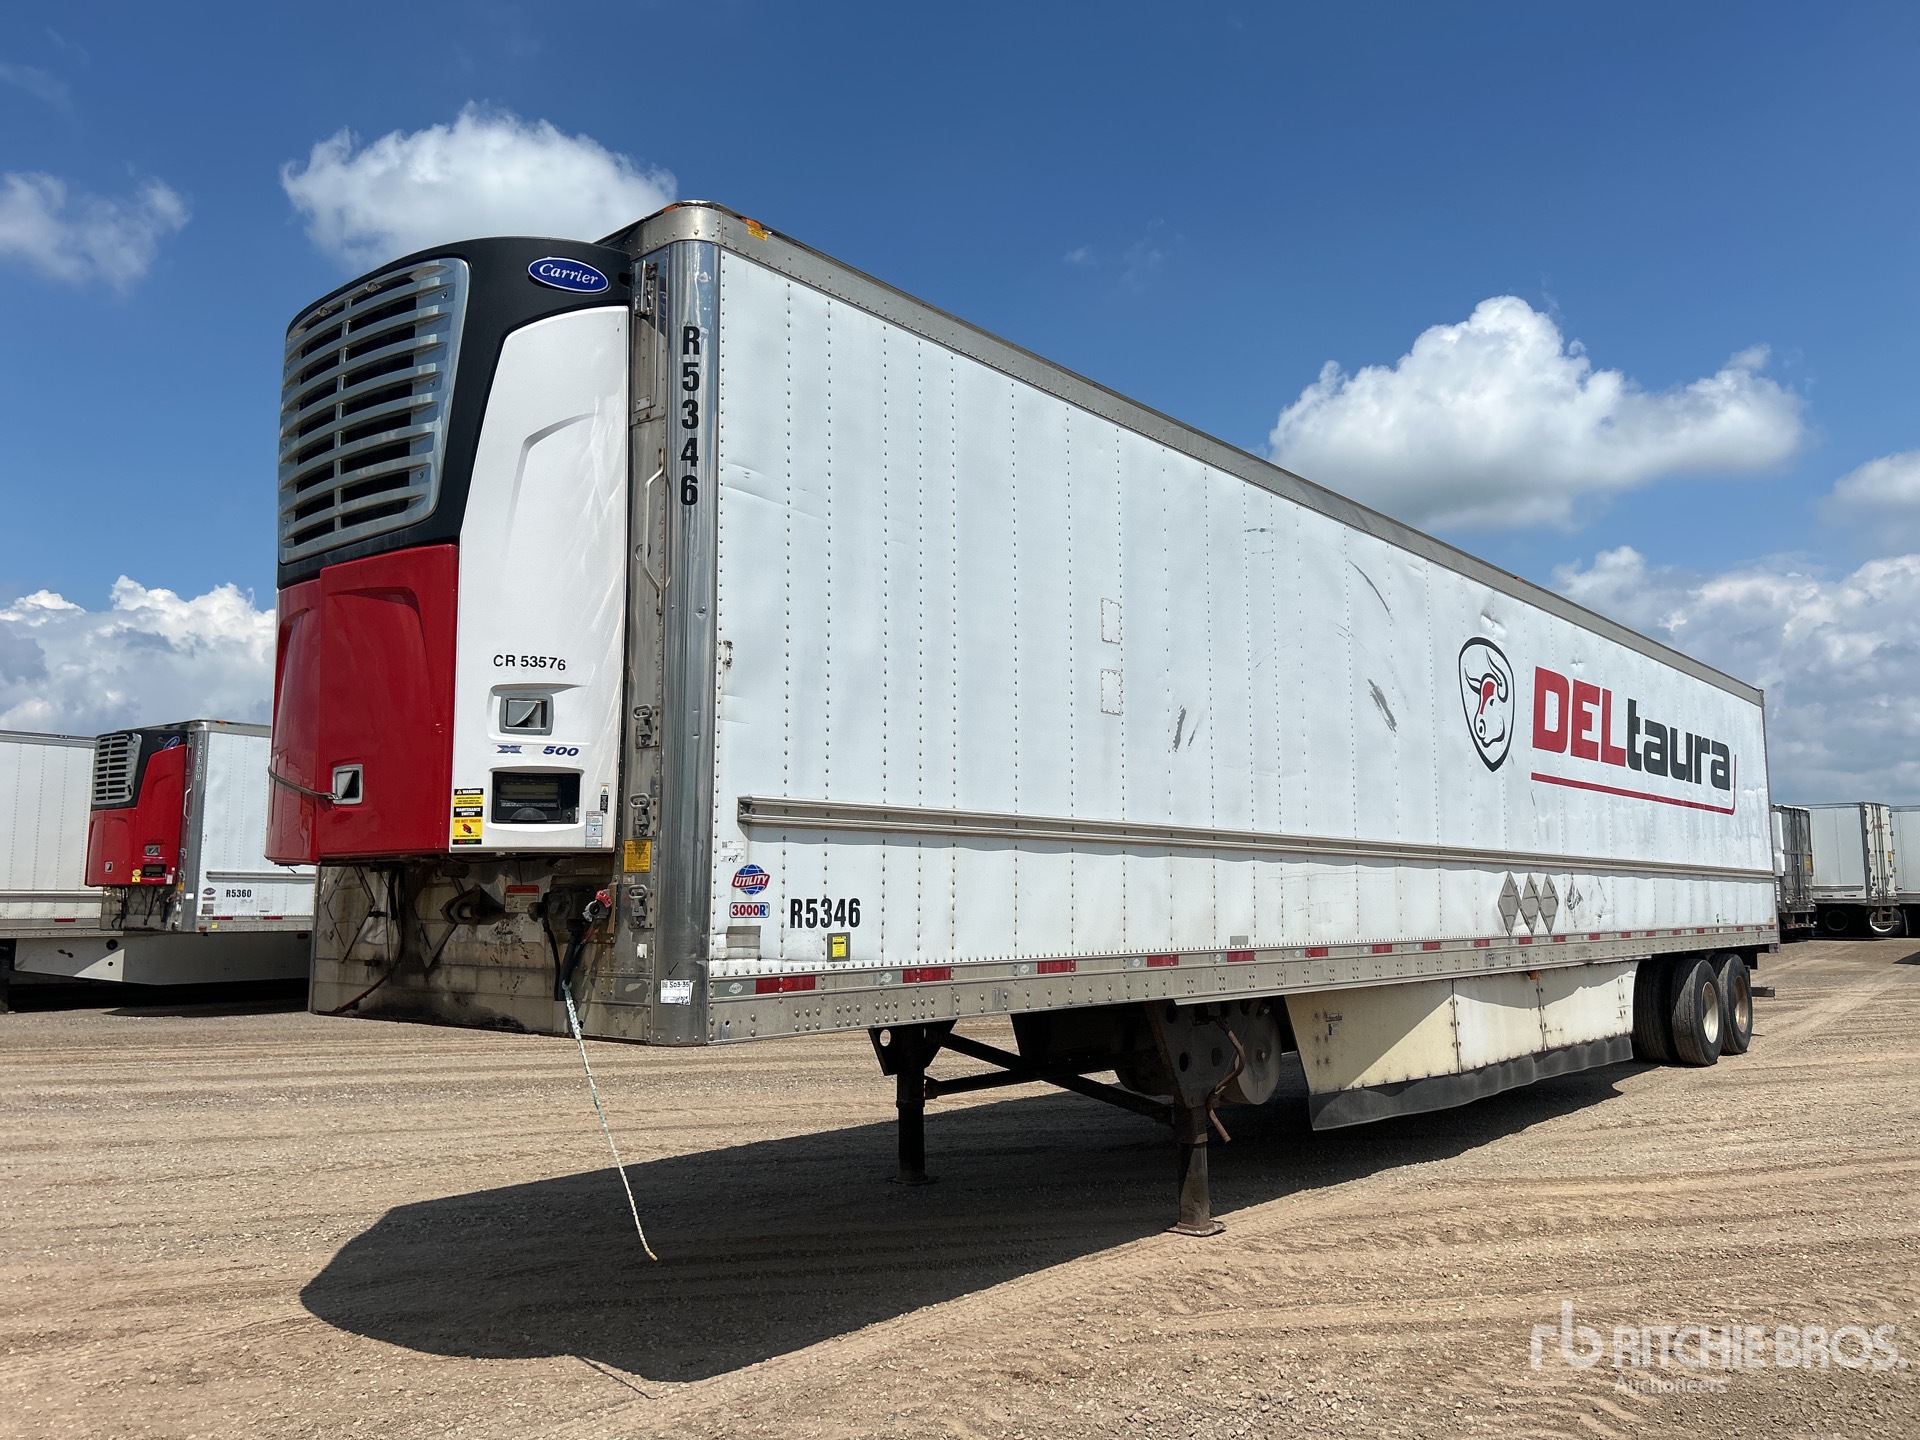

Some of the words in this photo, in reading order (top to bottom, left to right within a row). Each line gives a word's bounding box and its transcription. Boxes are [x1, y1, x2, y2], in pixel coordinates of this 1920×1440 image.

[539, 263, 599, 285] Carrier
[680, 325, 701, 506] R5346
[493, 654, 516, 667] CR
[520, 655, 567, 671] 53576
[1532, 665, 1731, 791] DELtaura
[542, 745, 580, 757] 500
[734, 874, 769, 887] UTILITY
[225, 889, 252, 898] R5360
[789, 897, 861, 929] R5346
